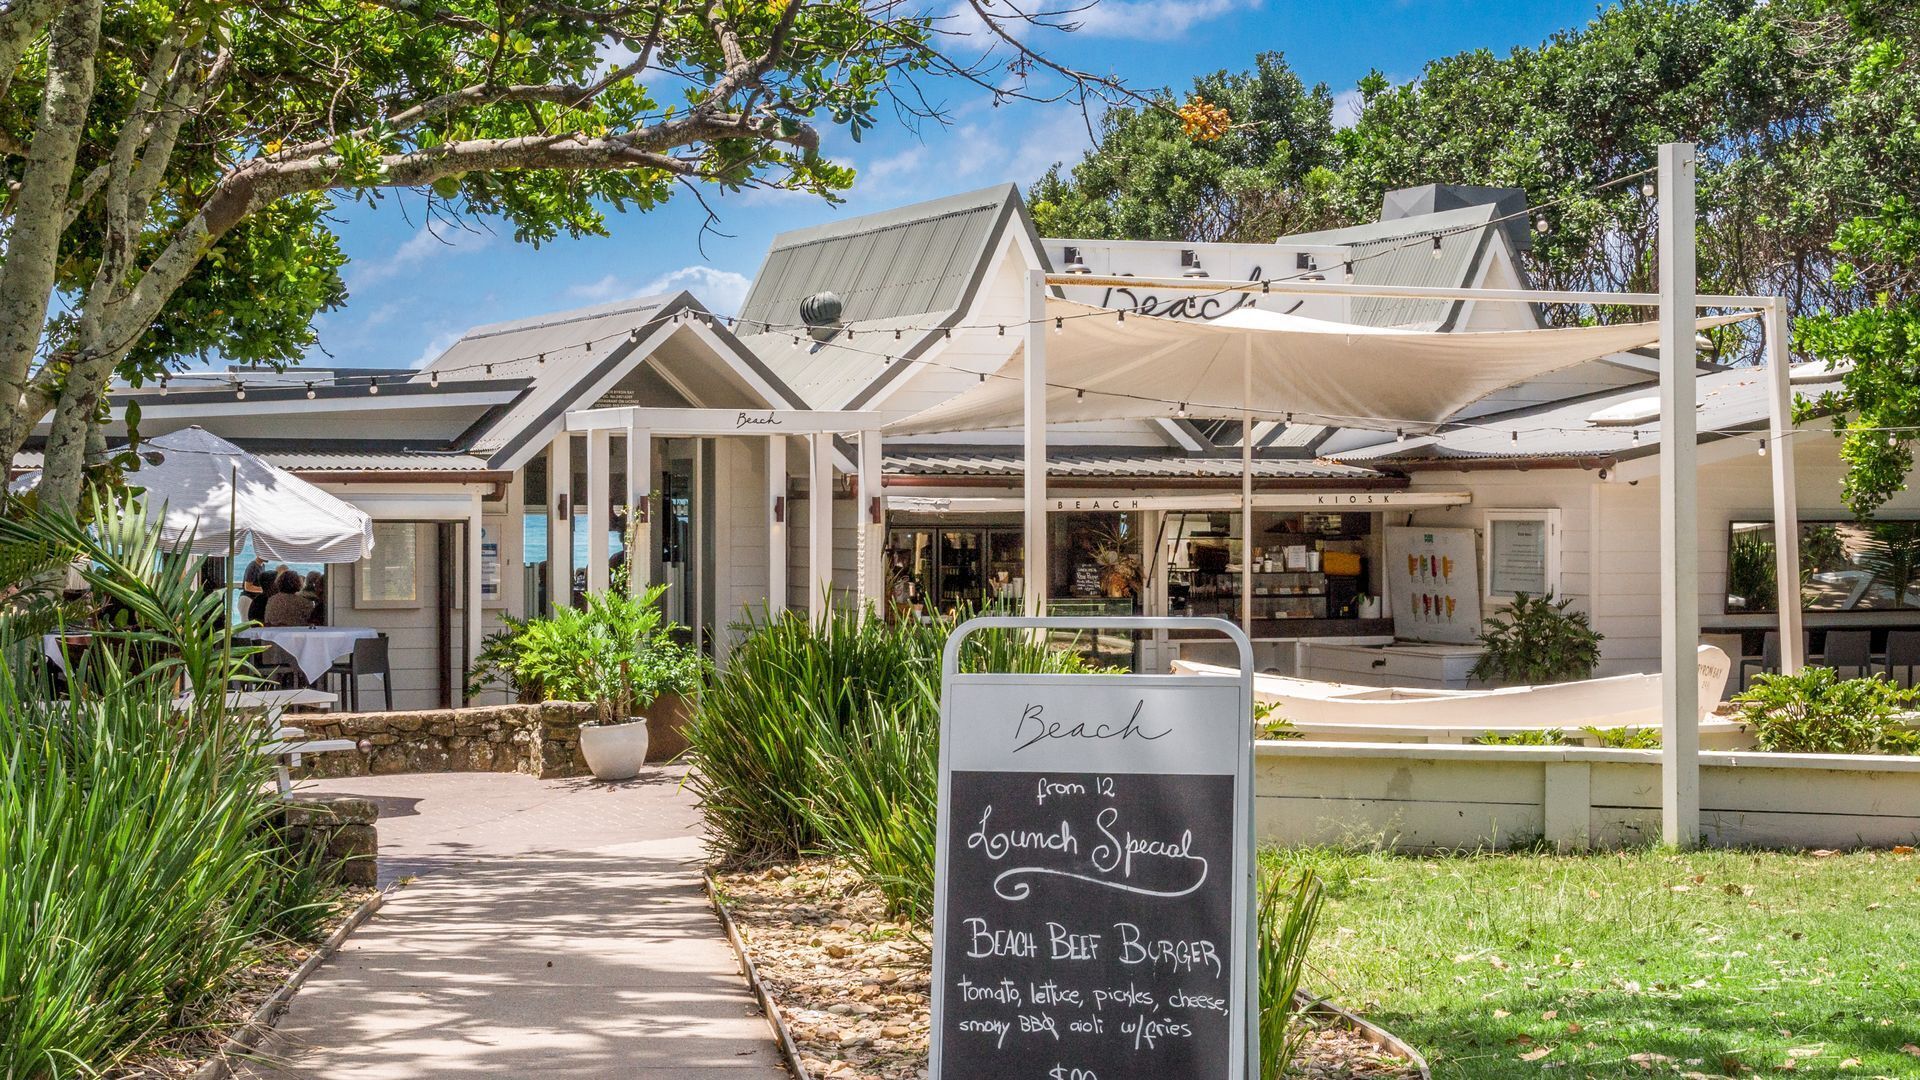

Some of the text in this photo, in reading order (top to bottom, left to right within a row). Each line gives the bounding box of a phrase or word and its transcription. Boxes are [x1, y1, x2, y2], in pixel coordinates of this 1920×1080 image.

[736, 411, 782, 429] Beach
[1057, 495, 1389, 509] BEACH KIOSK
[1012, 699, 1173, 753] Beach
[1037, 777, 1115, 805] from 12
[967, 804, 1207, 878] Lunch Special
[963, 918, 1221, 979] BEACH BEEF BURGER
[957, 973, 1229, 1017] tomato, lettuce, pickles, cheese,
[1018, 1011, 1060, 1041] BBQ
[1069, 1013, 1103, 1034] aioli
